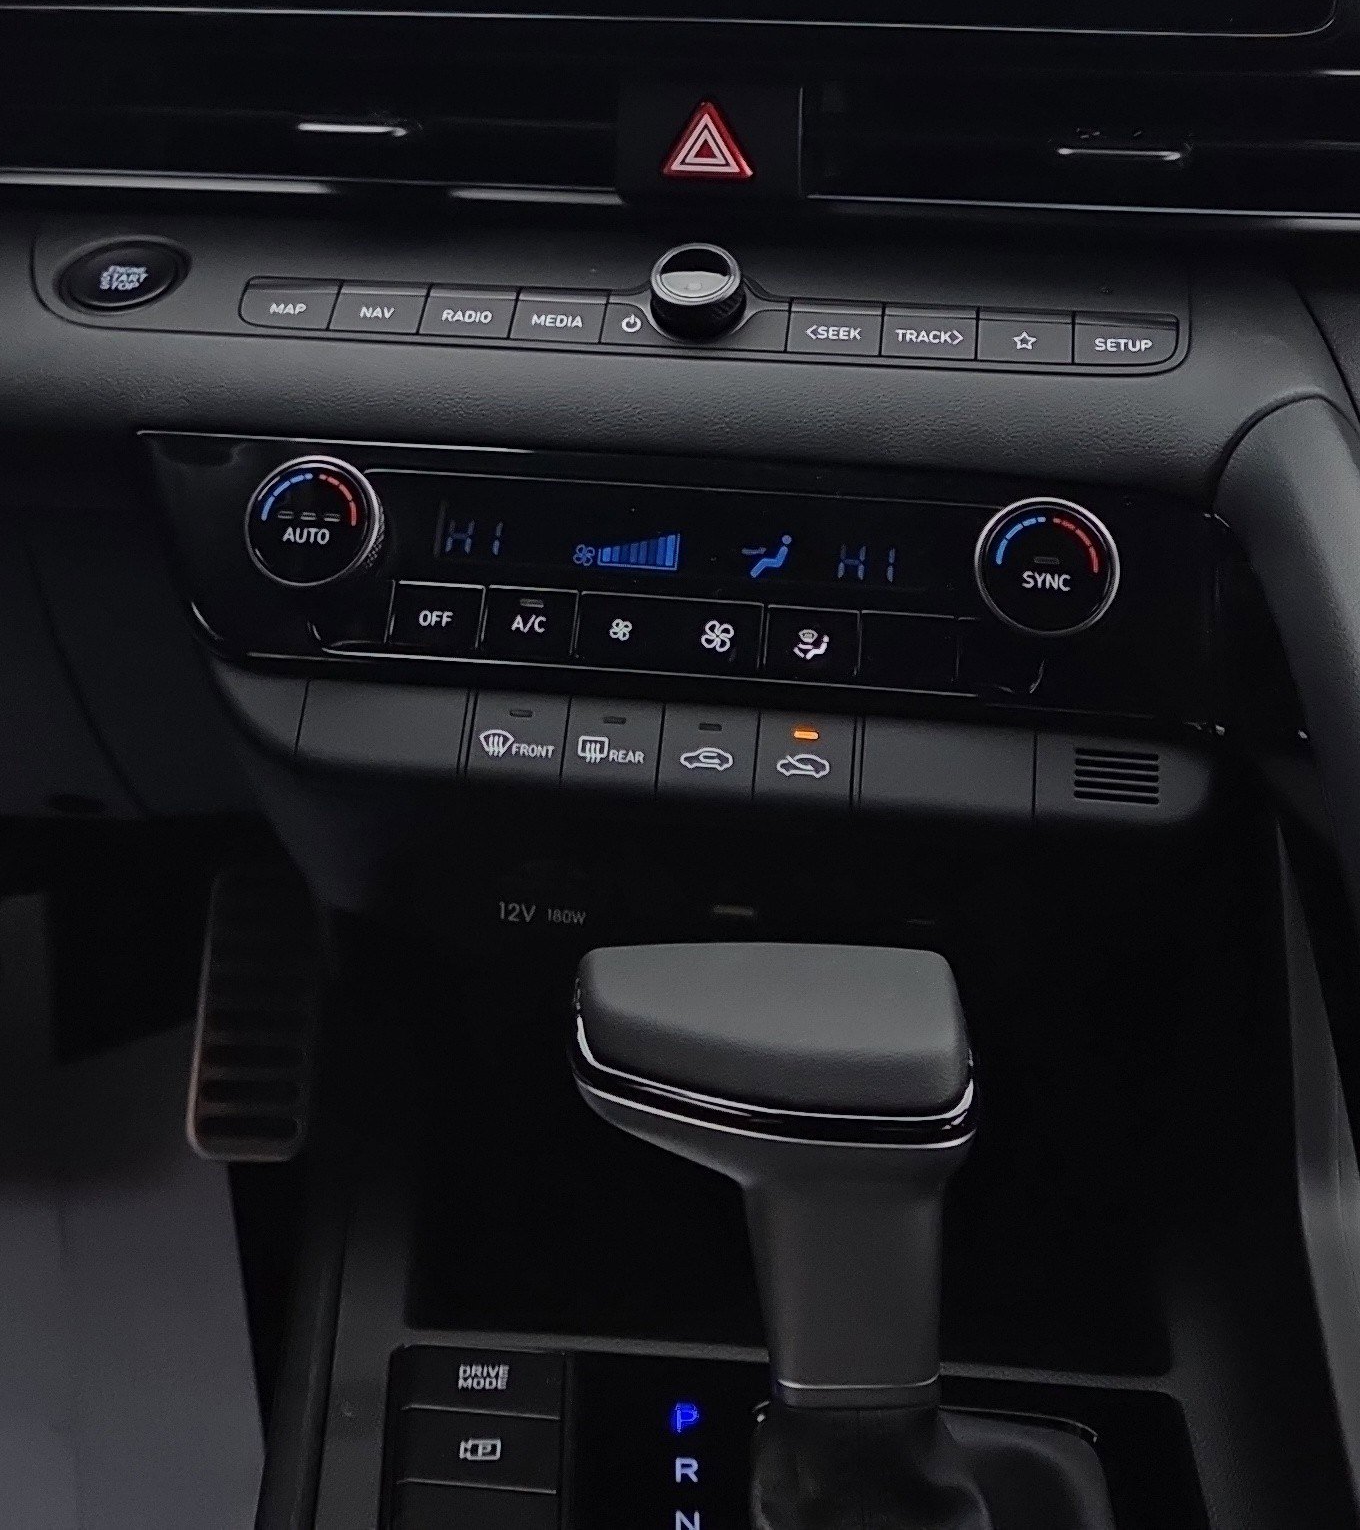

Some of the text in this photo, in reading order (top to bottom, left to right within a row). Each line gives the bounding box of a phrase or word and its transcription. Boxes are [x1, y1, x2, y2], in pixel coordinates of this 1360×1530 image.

[269, 302, 307, 316] MAP
[359, 306, 395, 320] NAV
[441, 309, 493, 324] RADIO
[531, 314, 583, 329] MEDIA
[1093, 337, 1153, 353] SETUP
[283, 527, 330, 545] AUTO
[1022, 571, 1071, 592] SYNC
[419, 610, 454, 627] OFF
[511, 615, 547, 633] A/C
[511, 743, 555, 758] FRONT
[608, 749, 645, 764] REAR
[499, 901, 587, 924] 12V 180W
[459, 1364, 509, 1377] DRIVE
[458, 1377, 507, 1390] MODE
[674, 1402, 699, 1433] P
[675, 1457, 699, 1483] R
[675, 1510, 700, 1530] N
